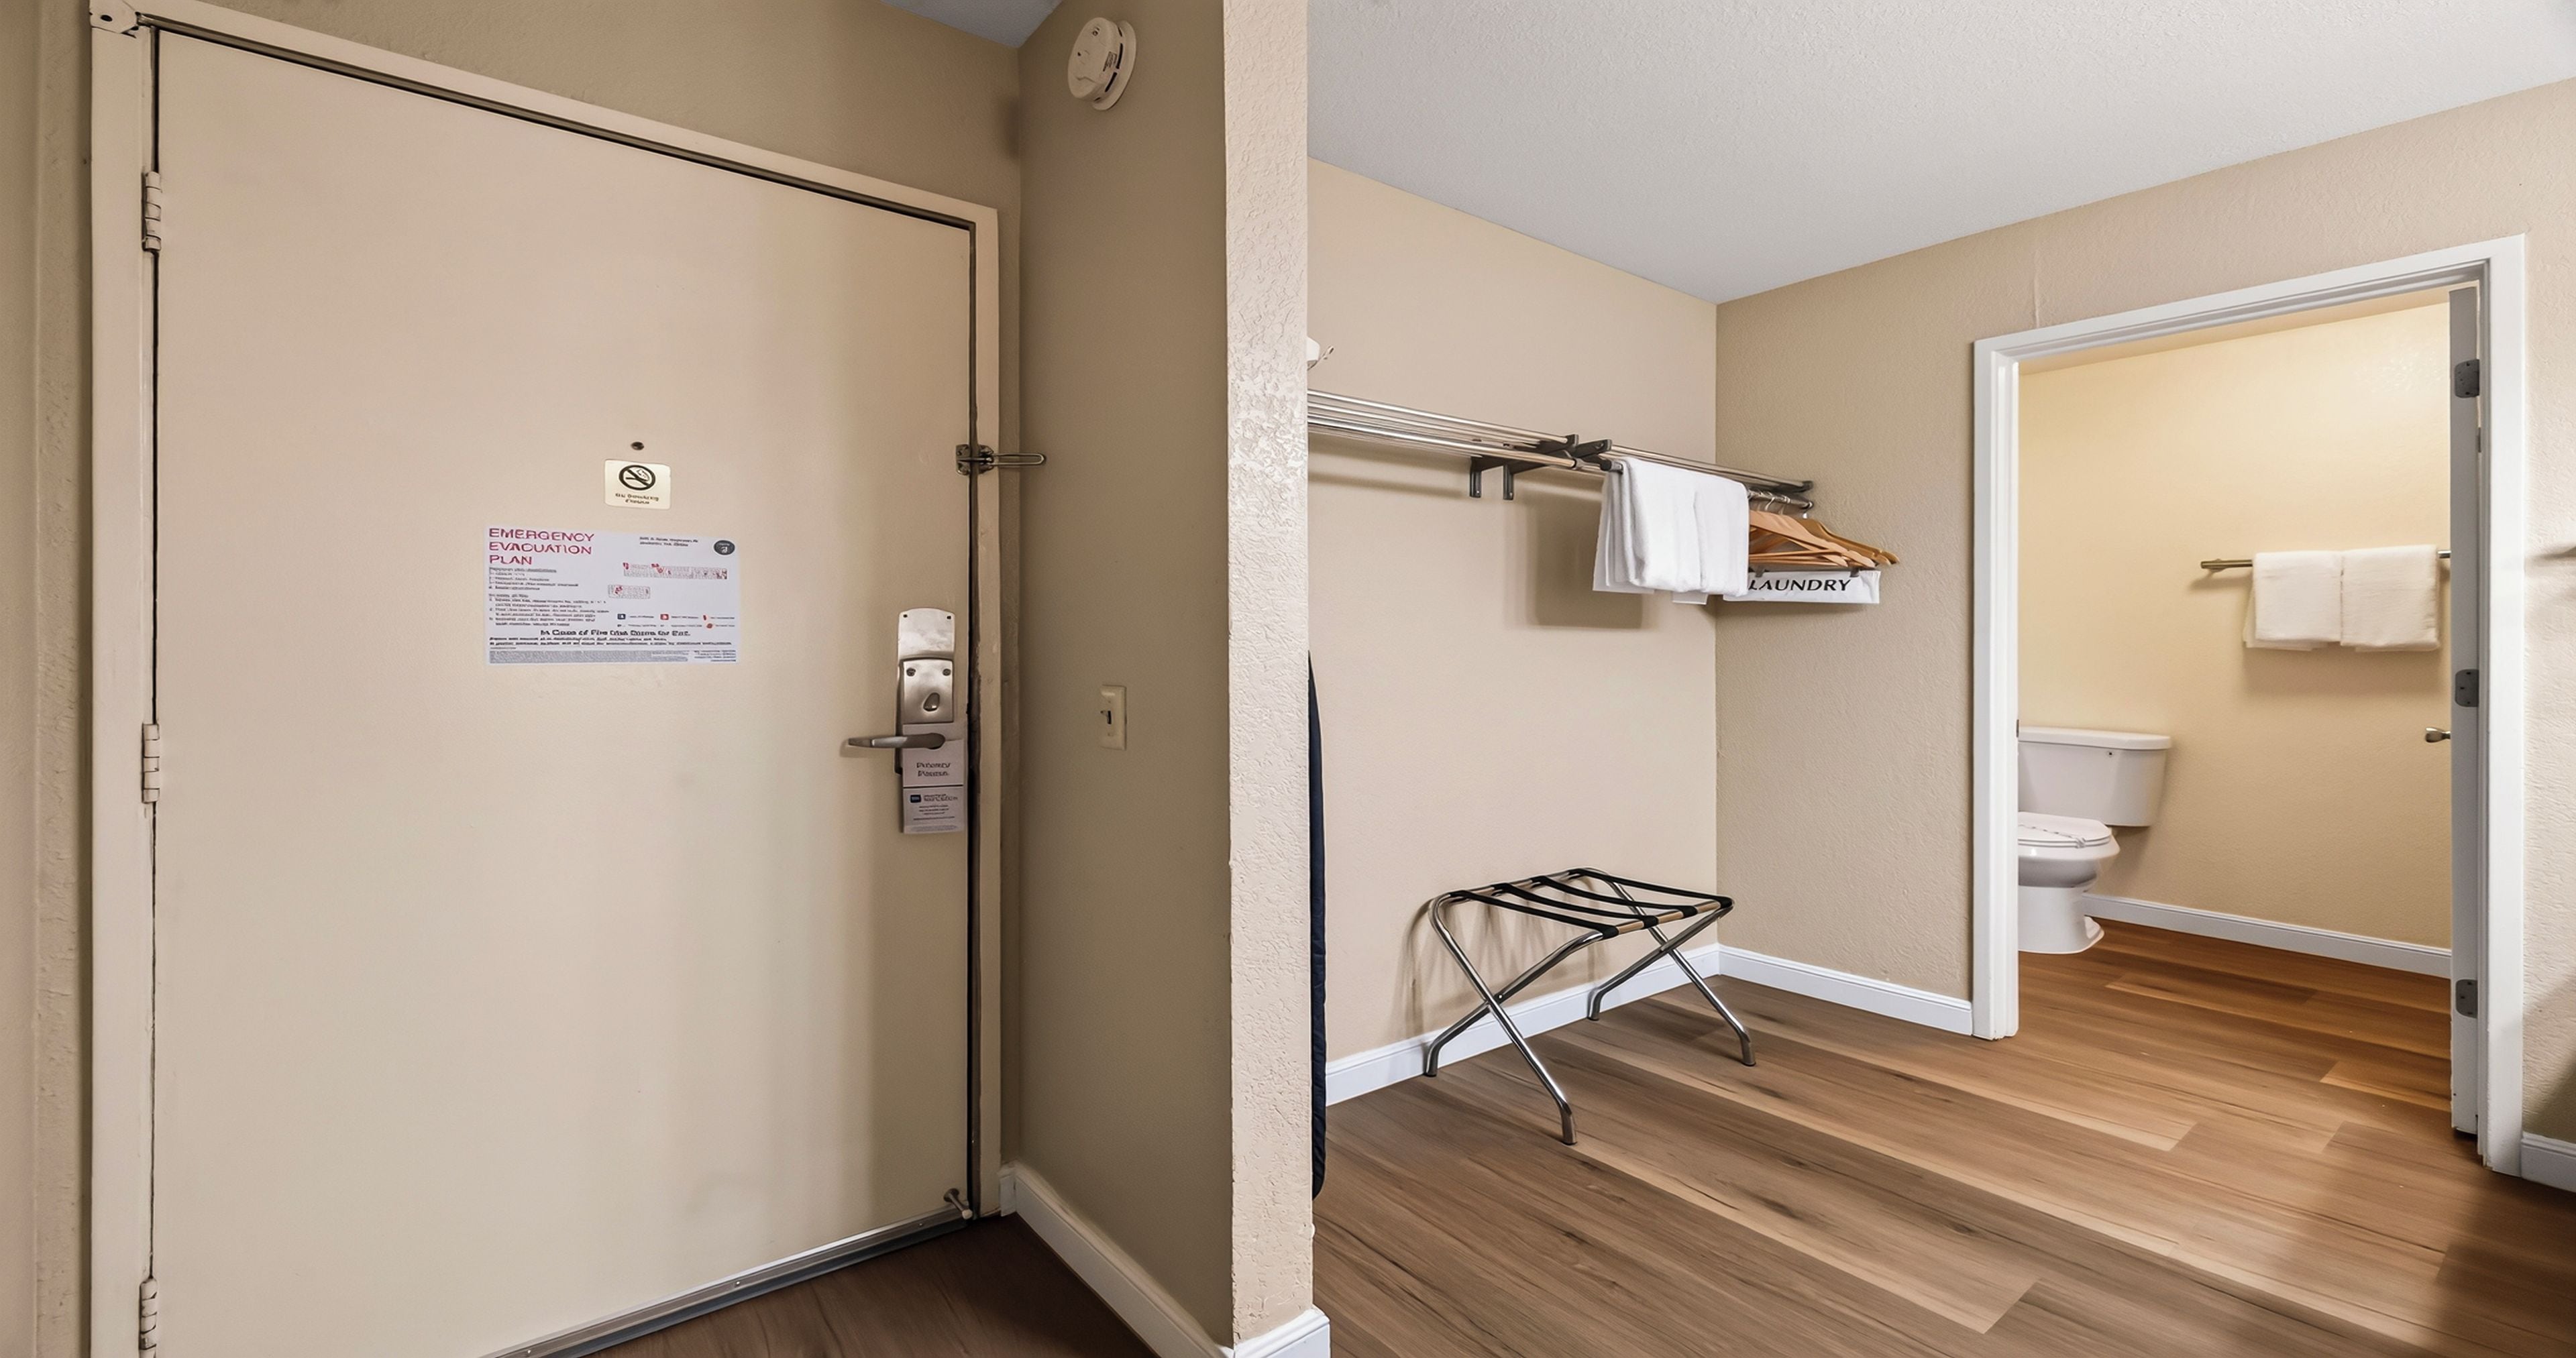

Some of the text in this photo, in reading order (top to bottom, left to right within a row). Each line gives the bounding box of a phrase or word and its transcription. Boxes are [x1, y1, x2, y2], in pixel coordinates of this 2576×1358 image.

[489, 528, 595, 542] EMERGENCY
[489, 542, 592, 555] EVACUATION
[489, 555, 532, 565] PLAN
[1748, 579, 1851, 591] LAUNDRY
